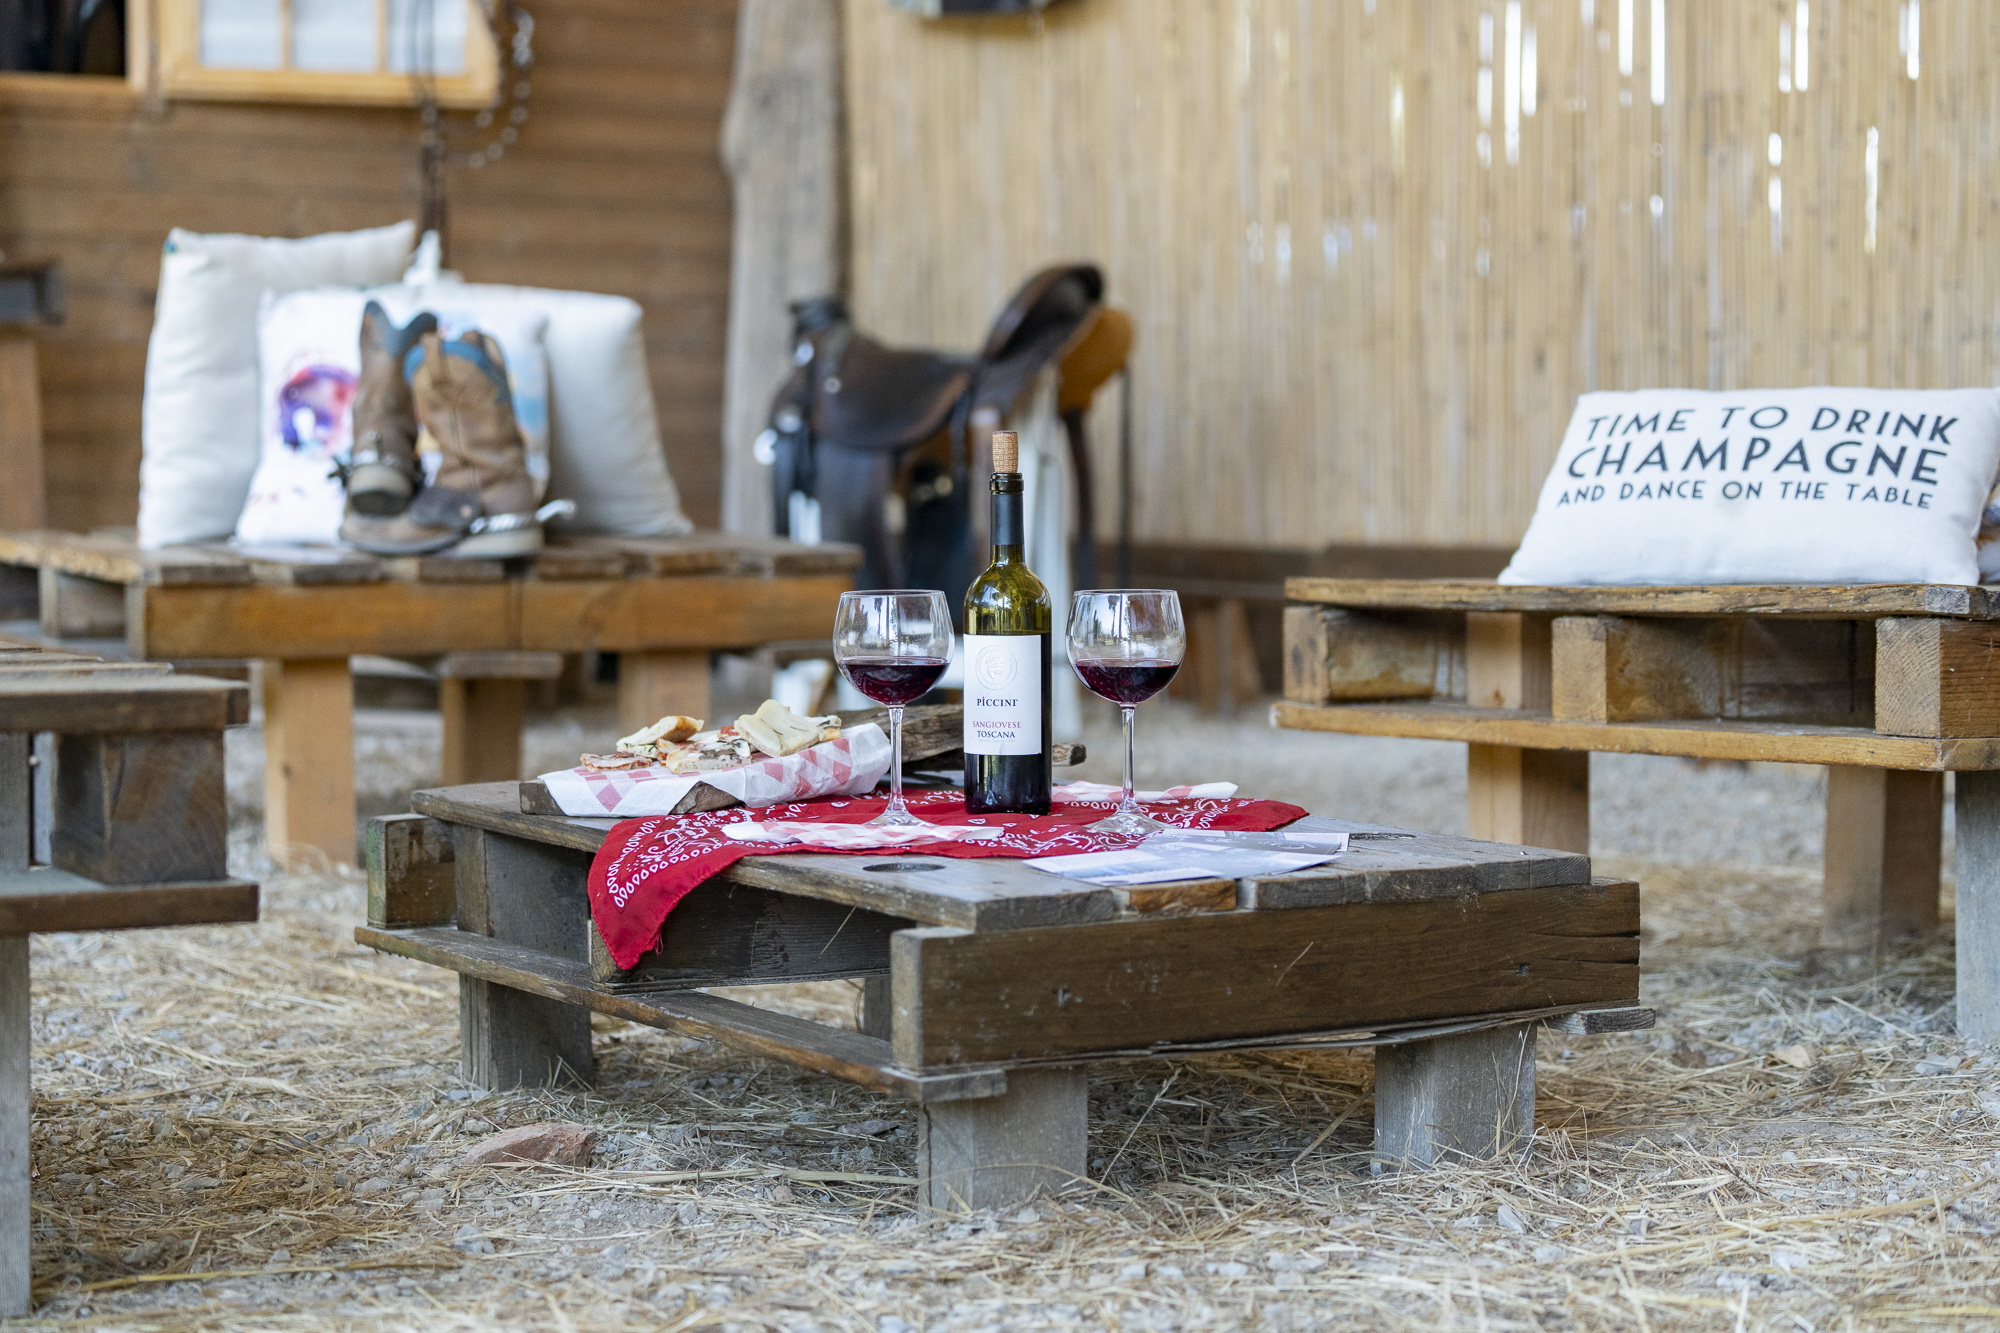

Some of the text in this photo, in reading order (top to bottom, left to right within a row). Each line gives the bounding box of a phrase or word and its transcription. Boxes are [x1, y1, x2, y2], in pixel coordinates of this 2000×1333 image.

[1588, 406, 1960, 446] TIME TO DRINK
[1568, 436, 1948, 486] CHAMPAGNE
[1556, 479, 1934, 510] AND DANCE ON THE TABLE
[972, 720, 1022, 729] SANGIOVESE
[976, 730, 1016, 739] TOSCANA
